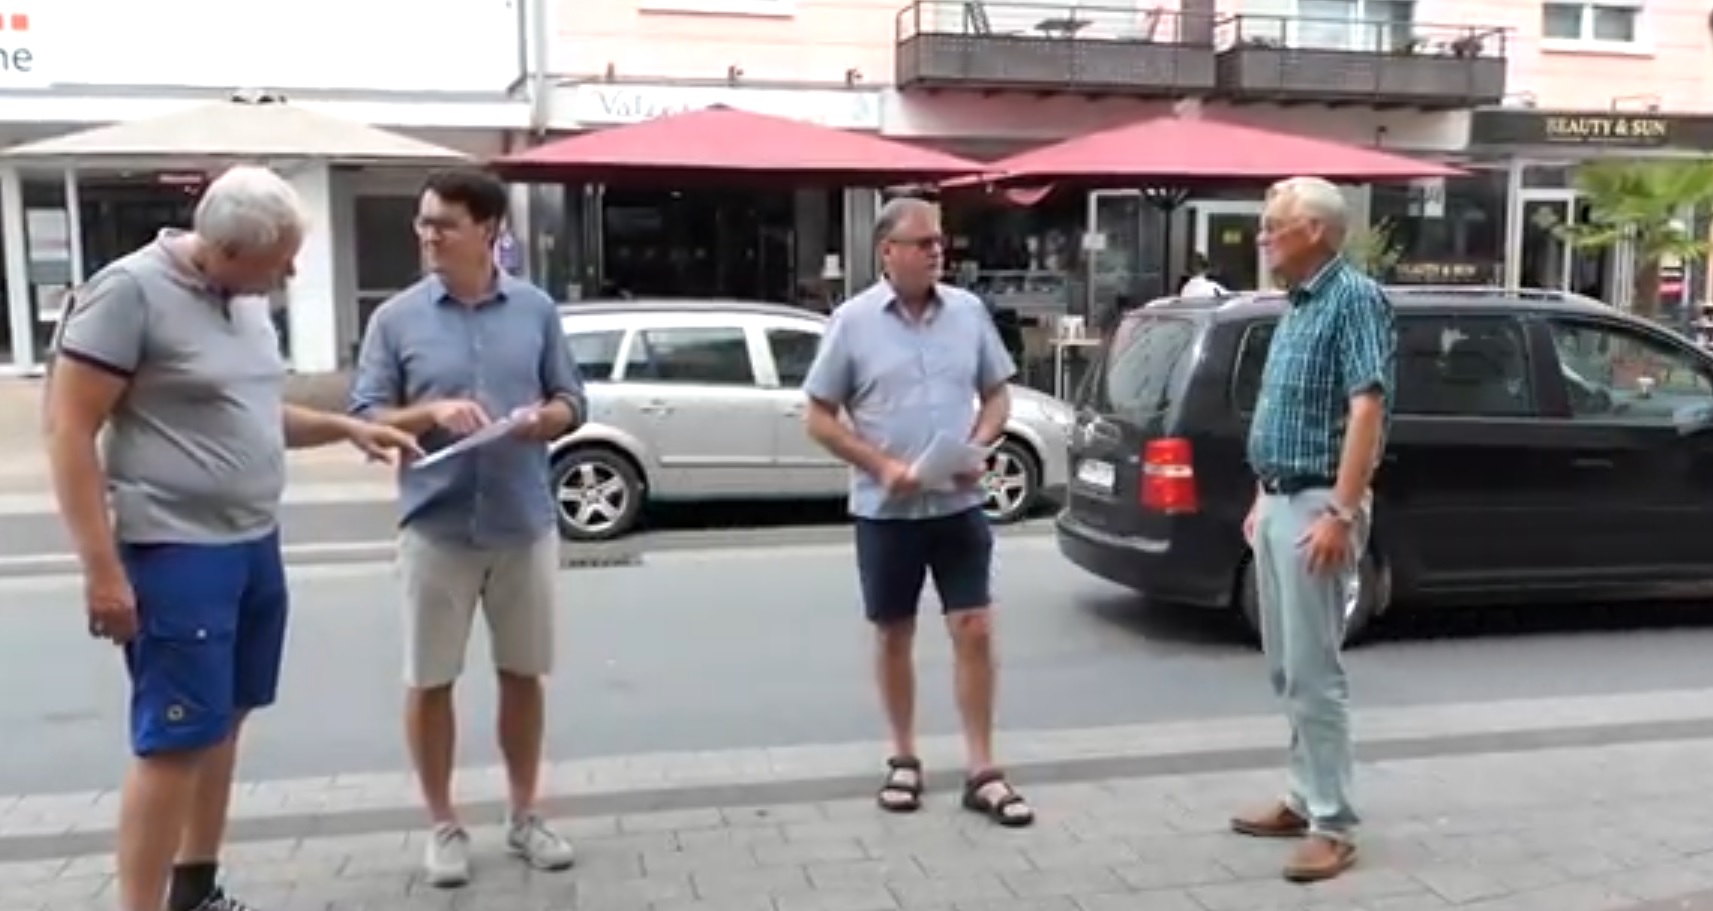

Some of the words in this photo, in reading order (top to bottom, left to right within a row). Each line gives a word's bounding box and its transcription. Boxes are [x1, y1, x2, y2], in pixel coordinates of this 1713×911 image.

[1546, 117, 1613, 135] BEAUTY
[1614, 118, 1628, 135] &
[1630, 119, 1667, 136] SUN
